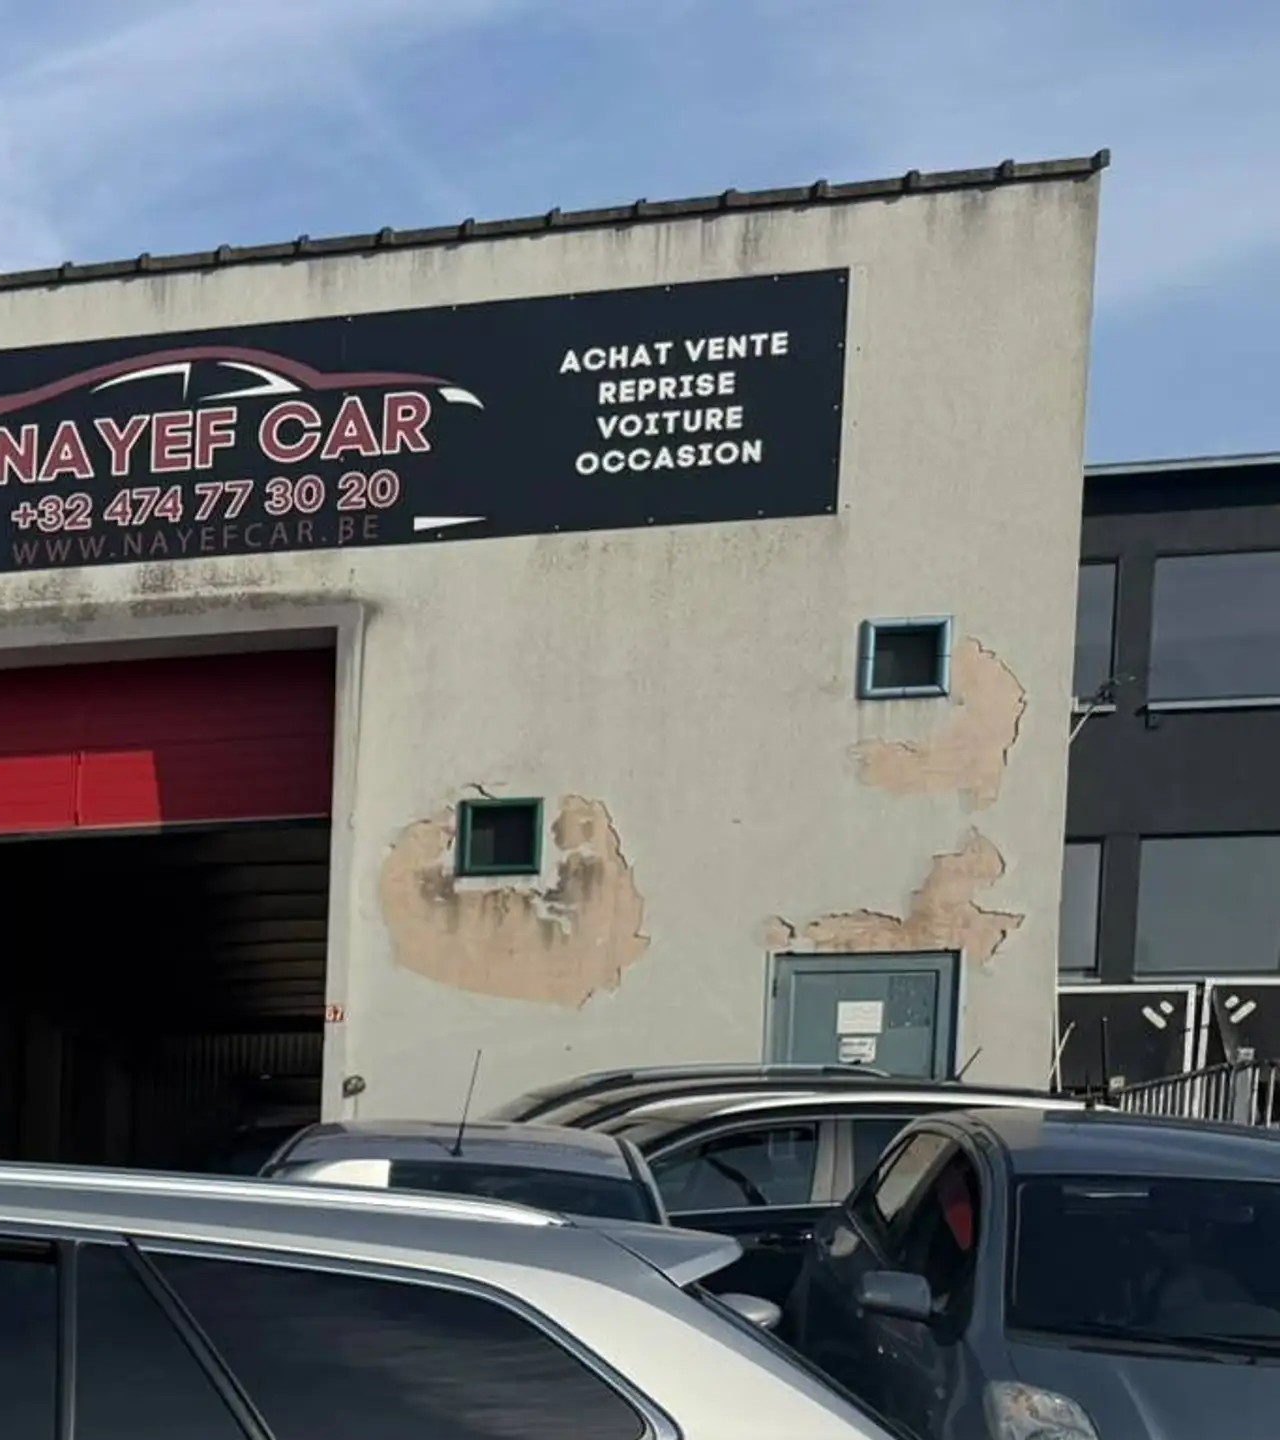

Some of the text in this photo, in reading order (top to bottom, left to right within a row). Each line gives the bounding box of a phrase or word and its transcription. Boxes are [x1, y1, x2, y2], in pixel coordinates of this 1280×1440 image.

[559, 331, 789, 374] ACHAT VENTE
[598, 371, 736, 405] REPRISE
[257, 391, 431, 463] CAR
[596, 405, 744, 440] VOITURE
[574, 438, 764, 476] OCCASION
[11, 468, 400, 533] +32 474 77 30 20
[11, 514, 381, 567] WWW.NAYEFCAR.BE
